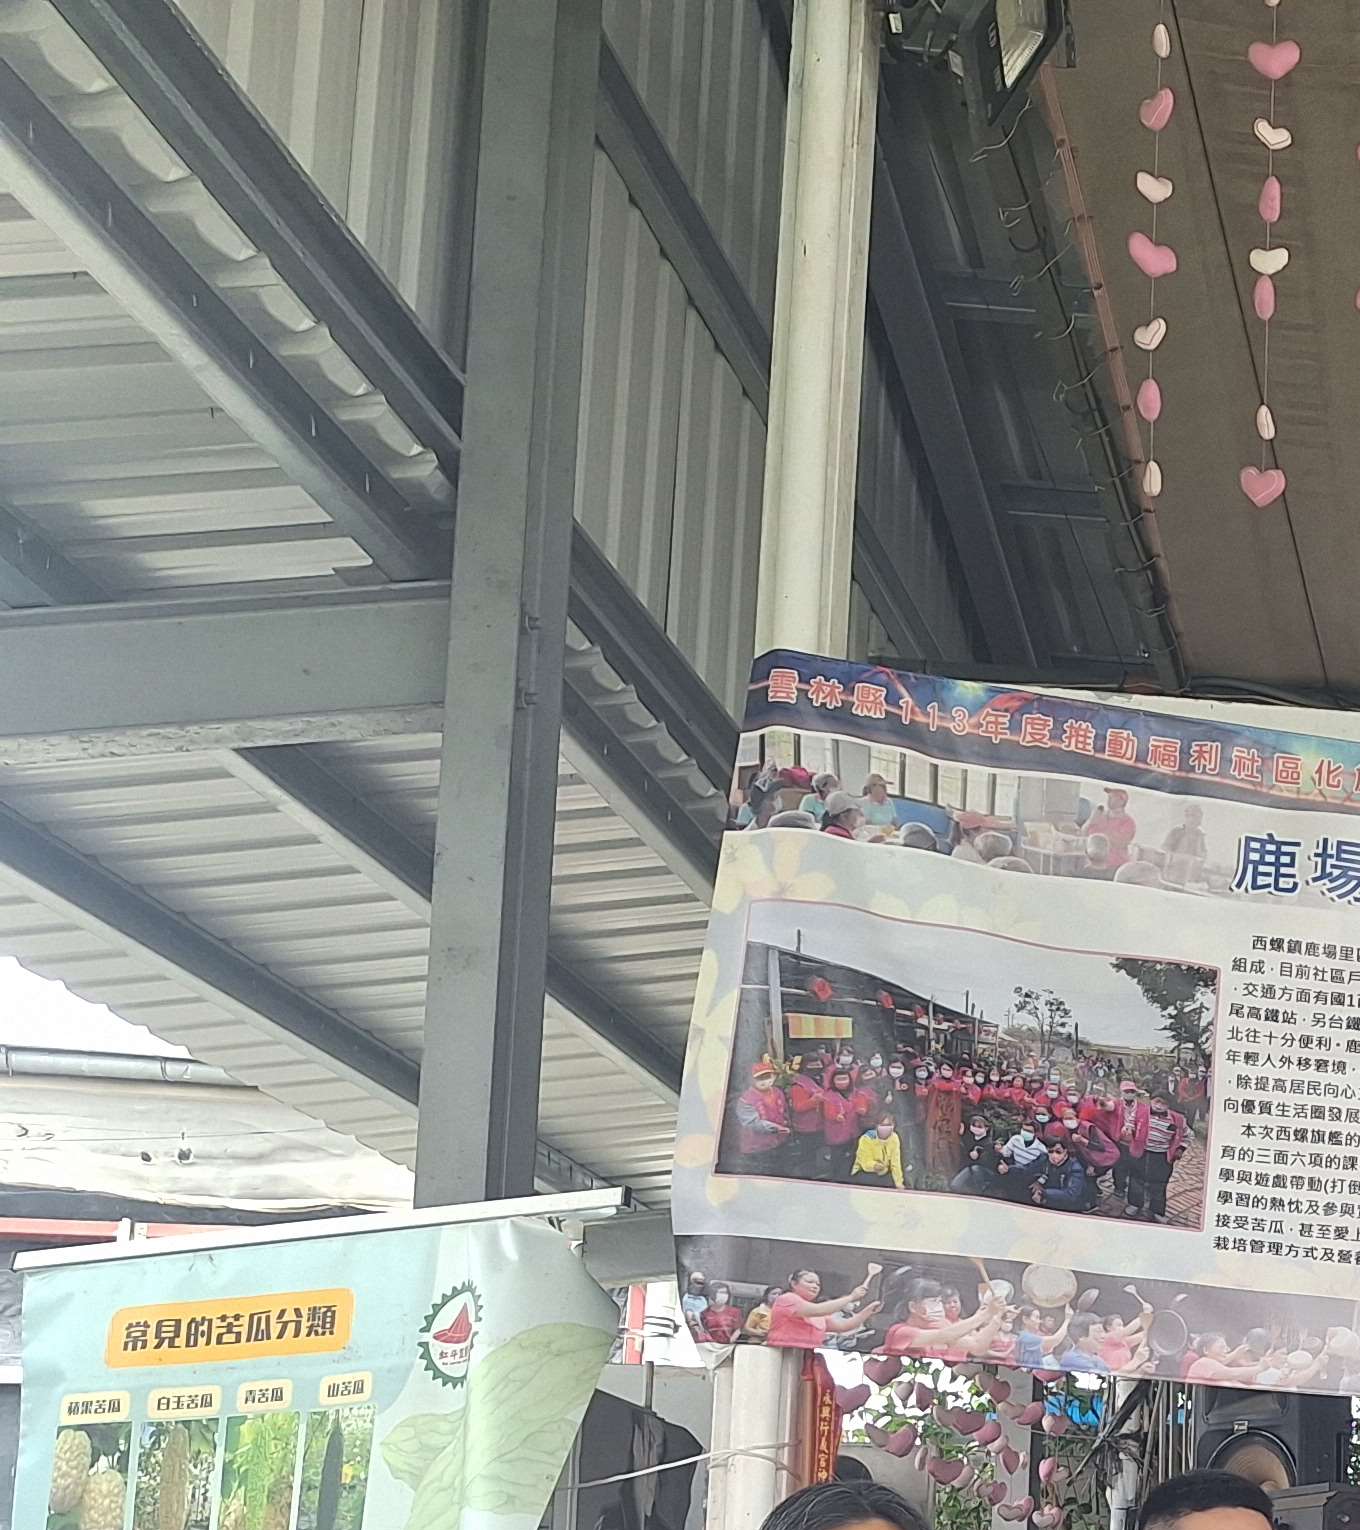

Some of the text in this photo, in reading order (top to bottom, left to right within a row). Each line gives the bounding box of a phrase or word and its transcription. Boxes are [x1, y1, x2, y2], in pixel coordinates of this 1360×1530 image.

[123, 1305, 338, 1351] 常見的苦瓜分類
[245, 1386, 284, 1405] 青苦瓜
[327, 1379, 365, 1398] 山苦瓜
[67, 1398, 121, 1417] 蘋果苦瓜
[156, 1393, 213, 1411] 白玉苦瓜
